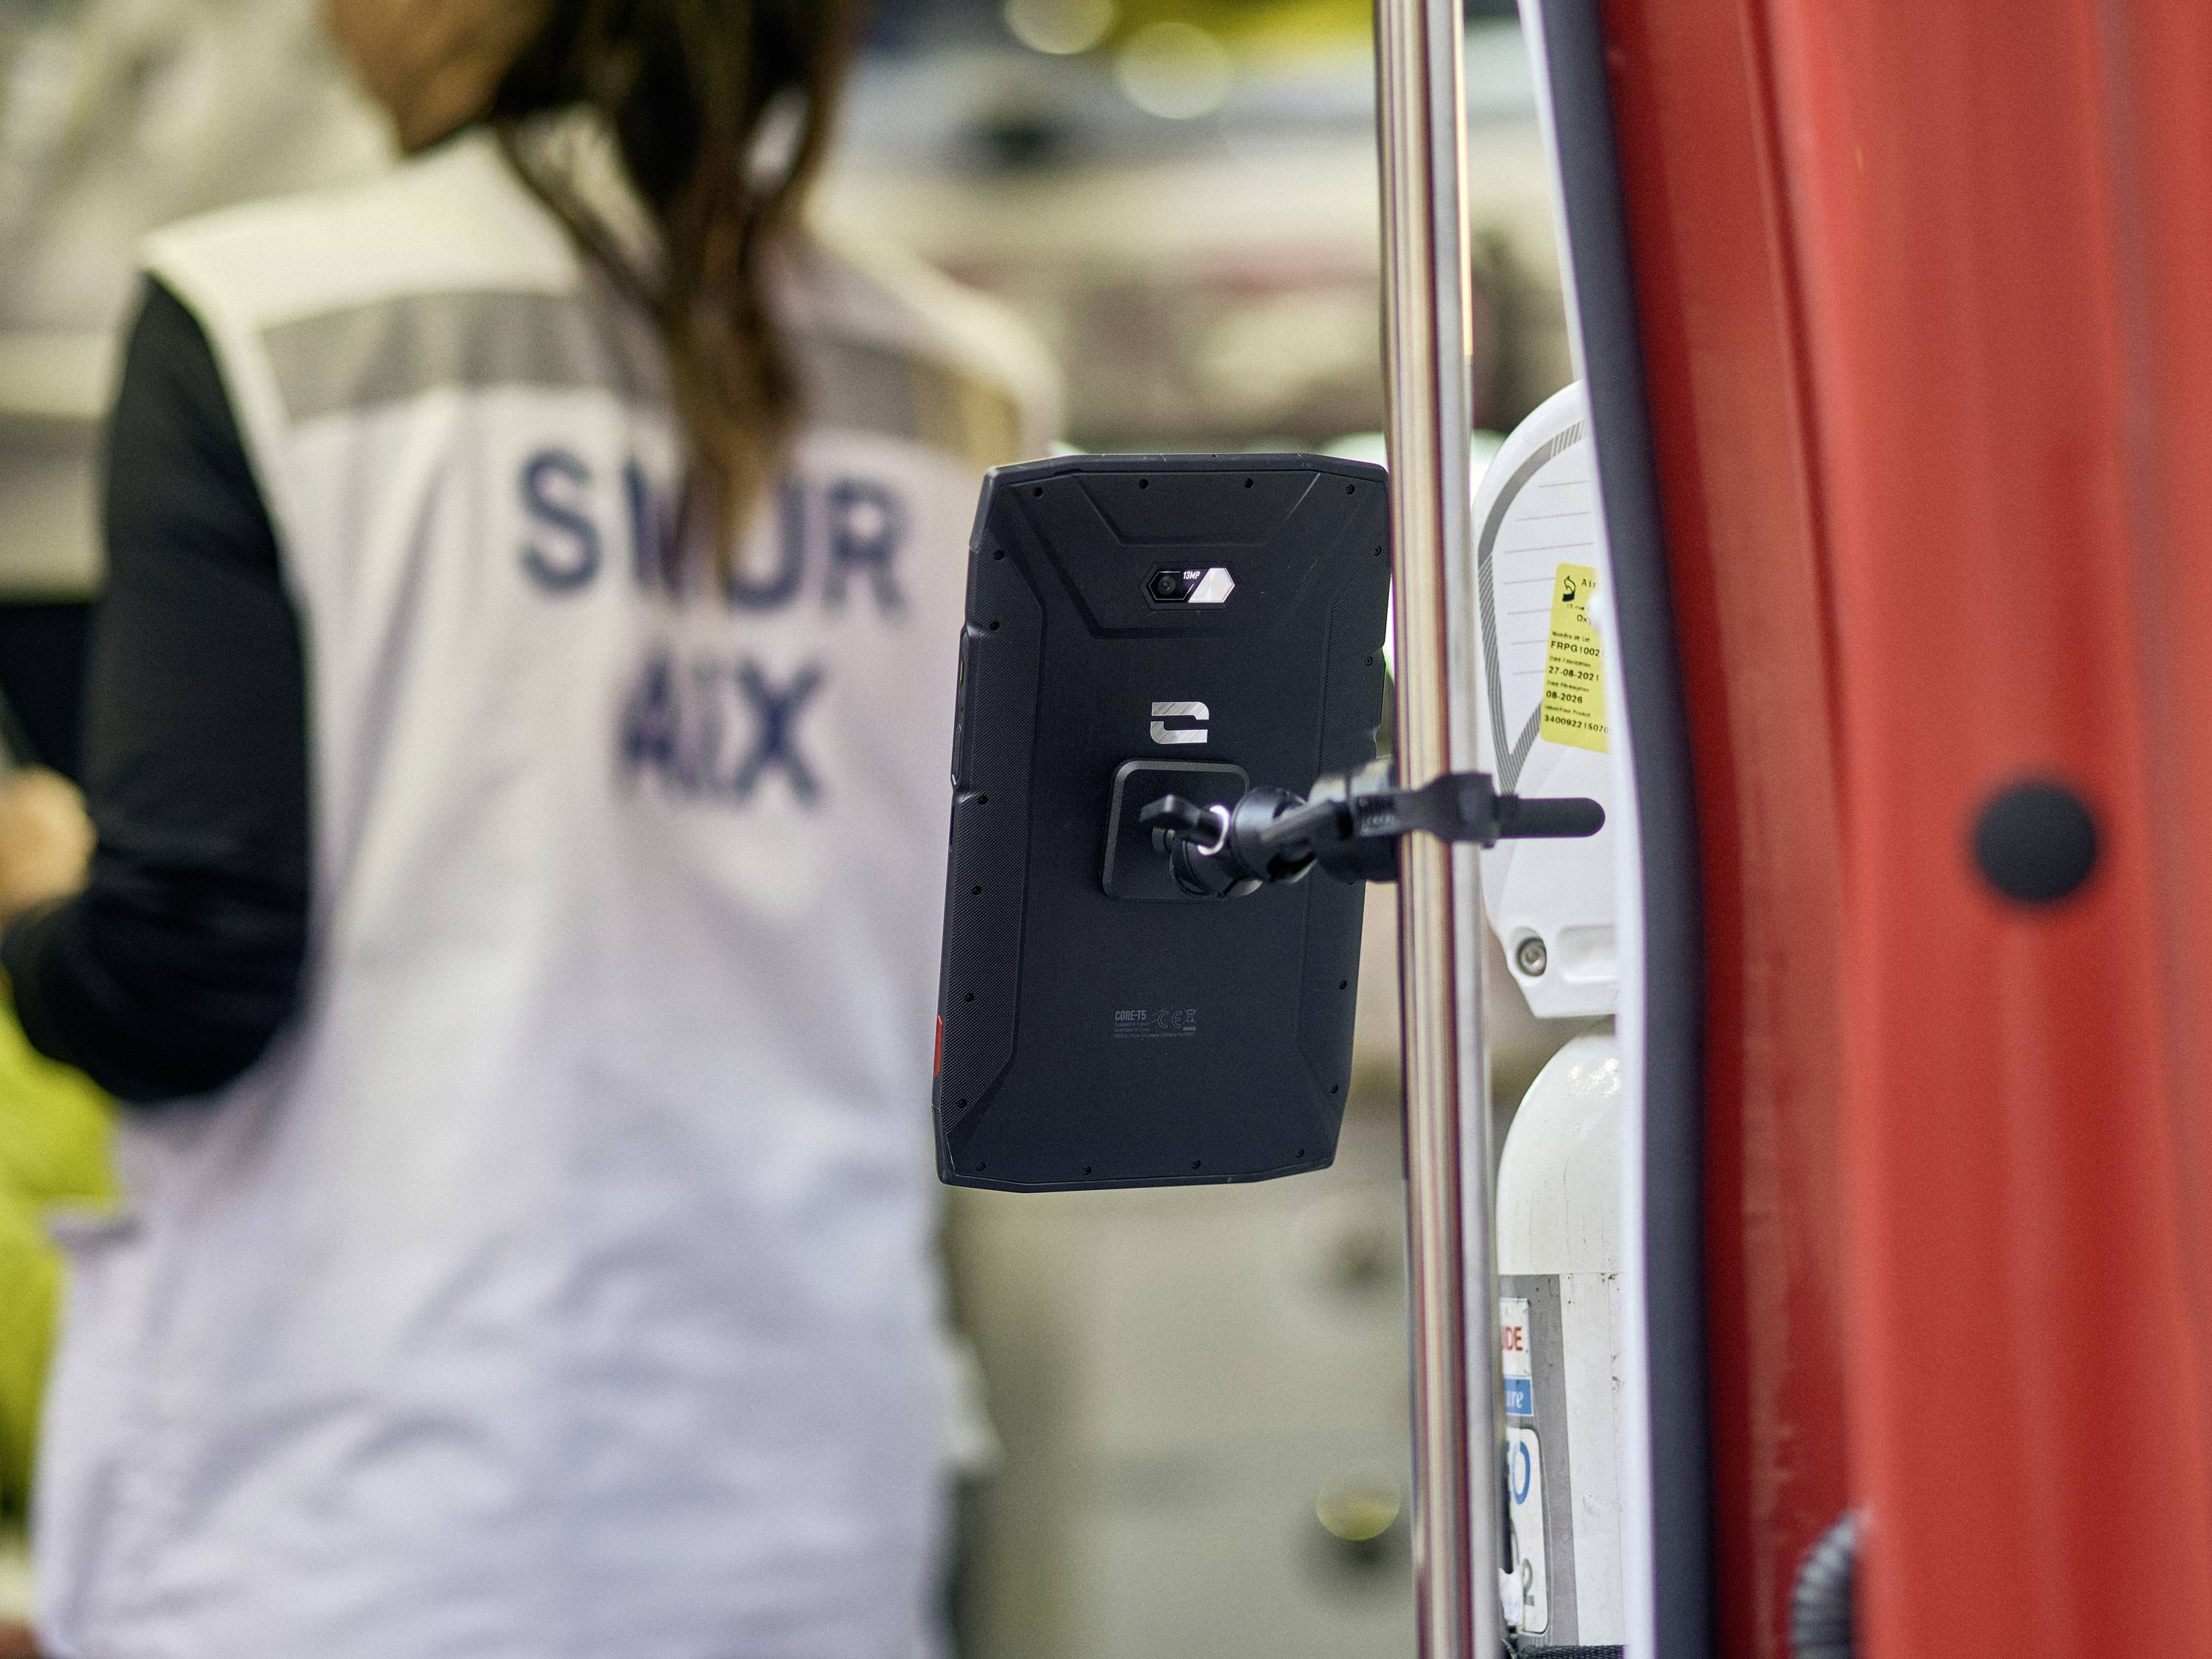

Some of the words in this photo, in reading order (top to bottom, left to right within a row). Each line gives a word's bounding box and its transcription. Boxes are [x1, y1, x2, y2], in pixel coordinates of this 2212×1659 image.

[1183, 571, 1200, 580] 13MP
[1551, 641, 1605, 657] FRPG1002
[1548, 666, 1599, 681] 27-08-2021
[1546, 690, 1583, 704] 08-2026
[1544, 714, 1610, 735] 340092215070
[1115, 1010, 1147, 1021] CORE-T5
